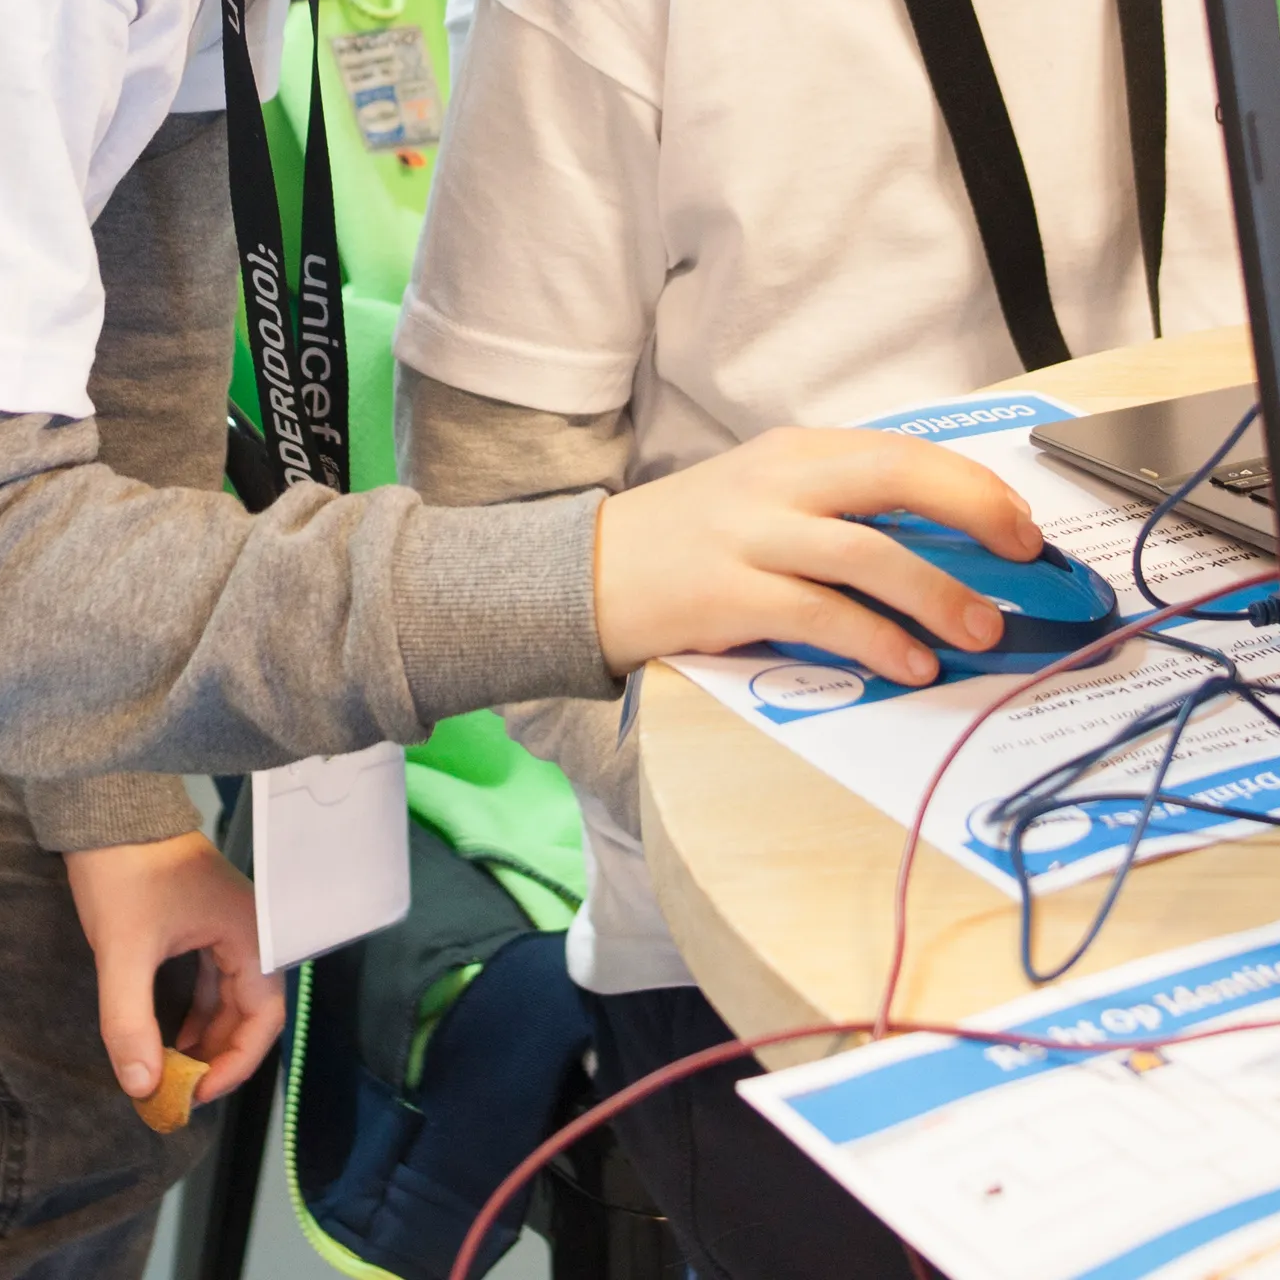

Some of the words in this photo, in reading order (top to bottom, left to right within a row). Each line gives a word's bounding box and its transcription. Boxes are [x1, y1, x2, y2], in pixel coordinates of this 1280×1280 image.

[300, 253, 343, 447] unicef
[246, 242, 315, 486] ODER(DOJO);
[1062, 523, 1094, 536] een
[1166, 527, 1214, 544] Maak
[1180, 549, 1212, 568] spel
[1215, 543, 1245, 556] Het
[1145, 558, 1177, 572] kan
[1213, 550, 1262, 569] Maak
[1171, 565, 1205, 579] een
[1131, 656, 1182, 682] geluid
[1177, 665, 1204, 684] bij
[779, 677, 855, 702] Niveau
[795, 674, 811, 687] 3
[1033, 670, 1130, 703] bibliotheek
[1131, 675, 1175, 696] elke
[1085, 684, 1129, 704] keer
[1008, 694, 1081, 722] vangen
[1085, 715, 1110, 731] het
[1040, 723, 1078, 745] spel
[1183, 721, 1241, 747] aparte
[1203, 738, 1240, 756] mis
[982, 1018, 1108, 1072] Reht
[1100, 996, 1165, 1040] Op
